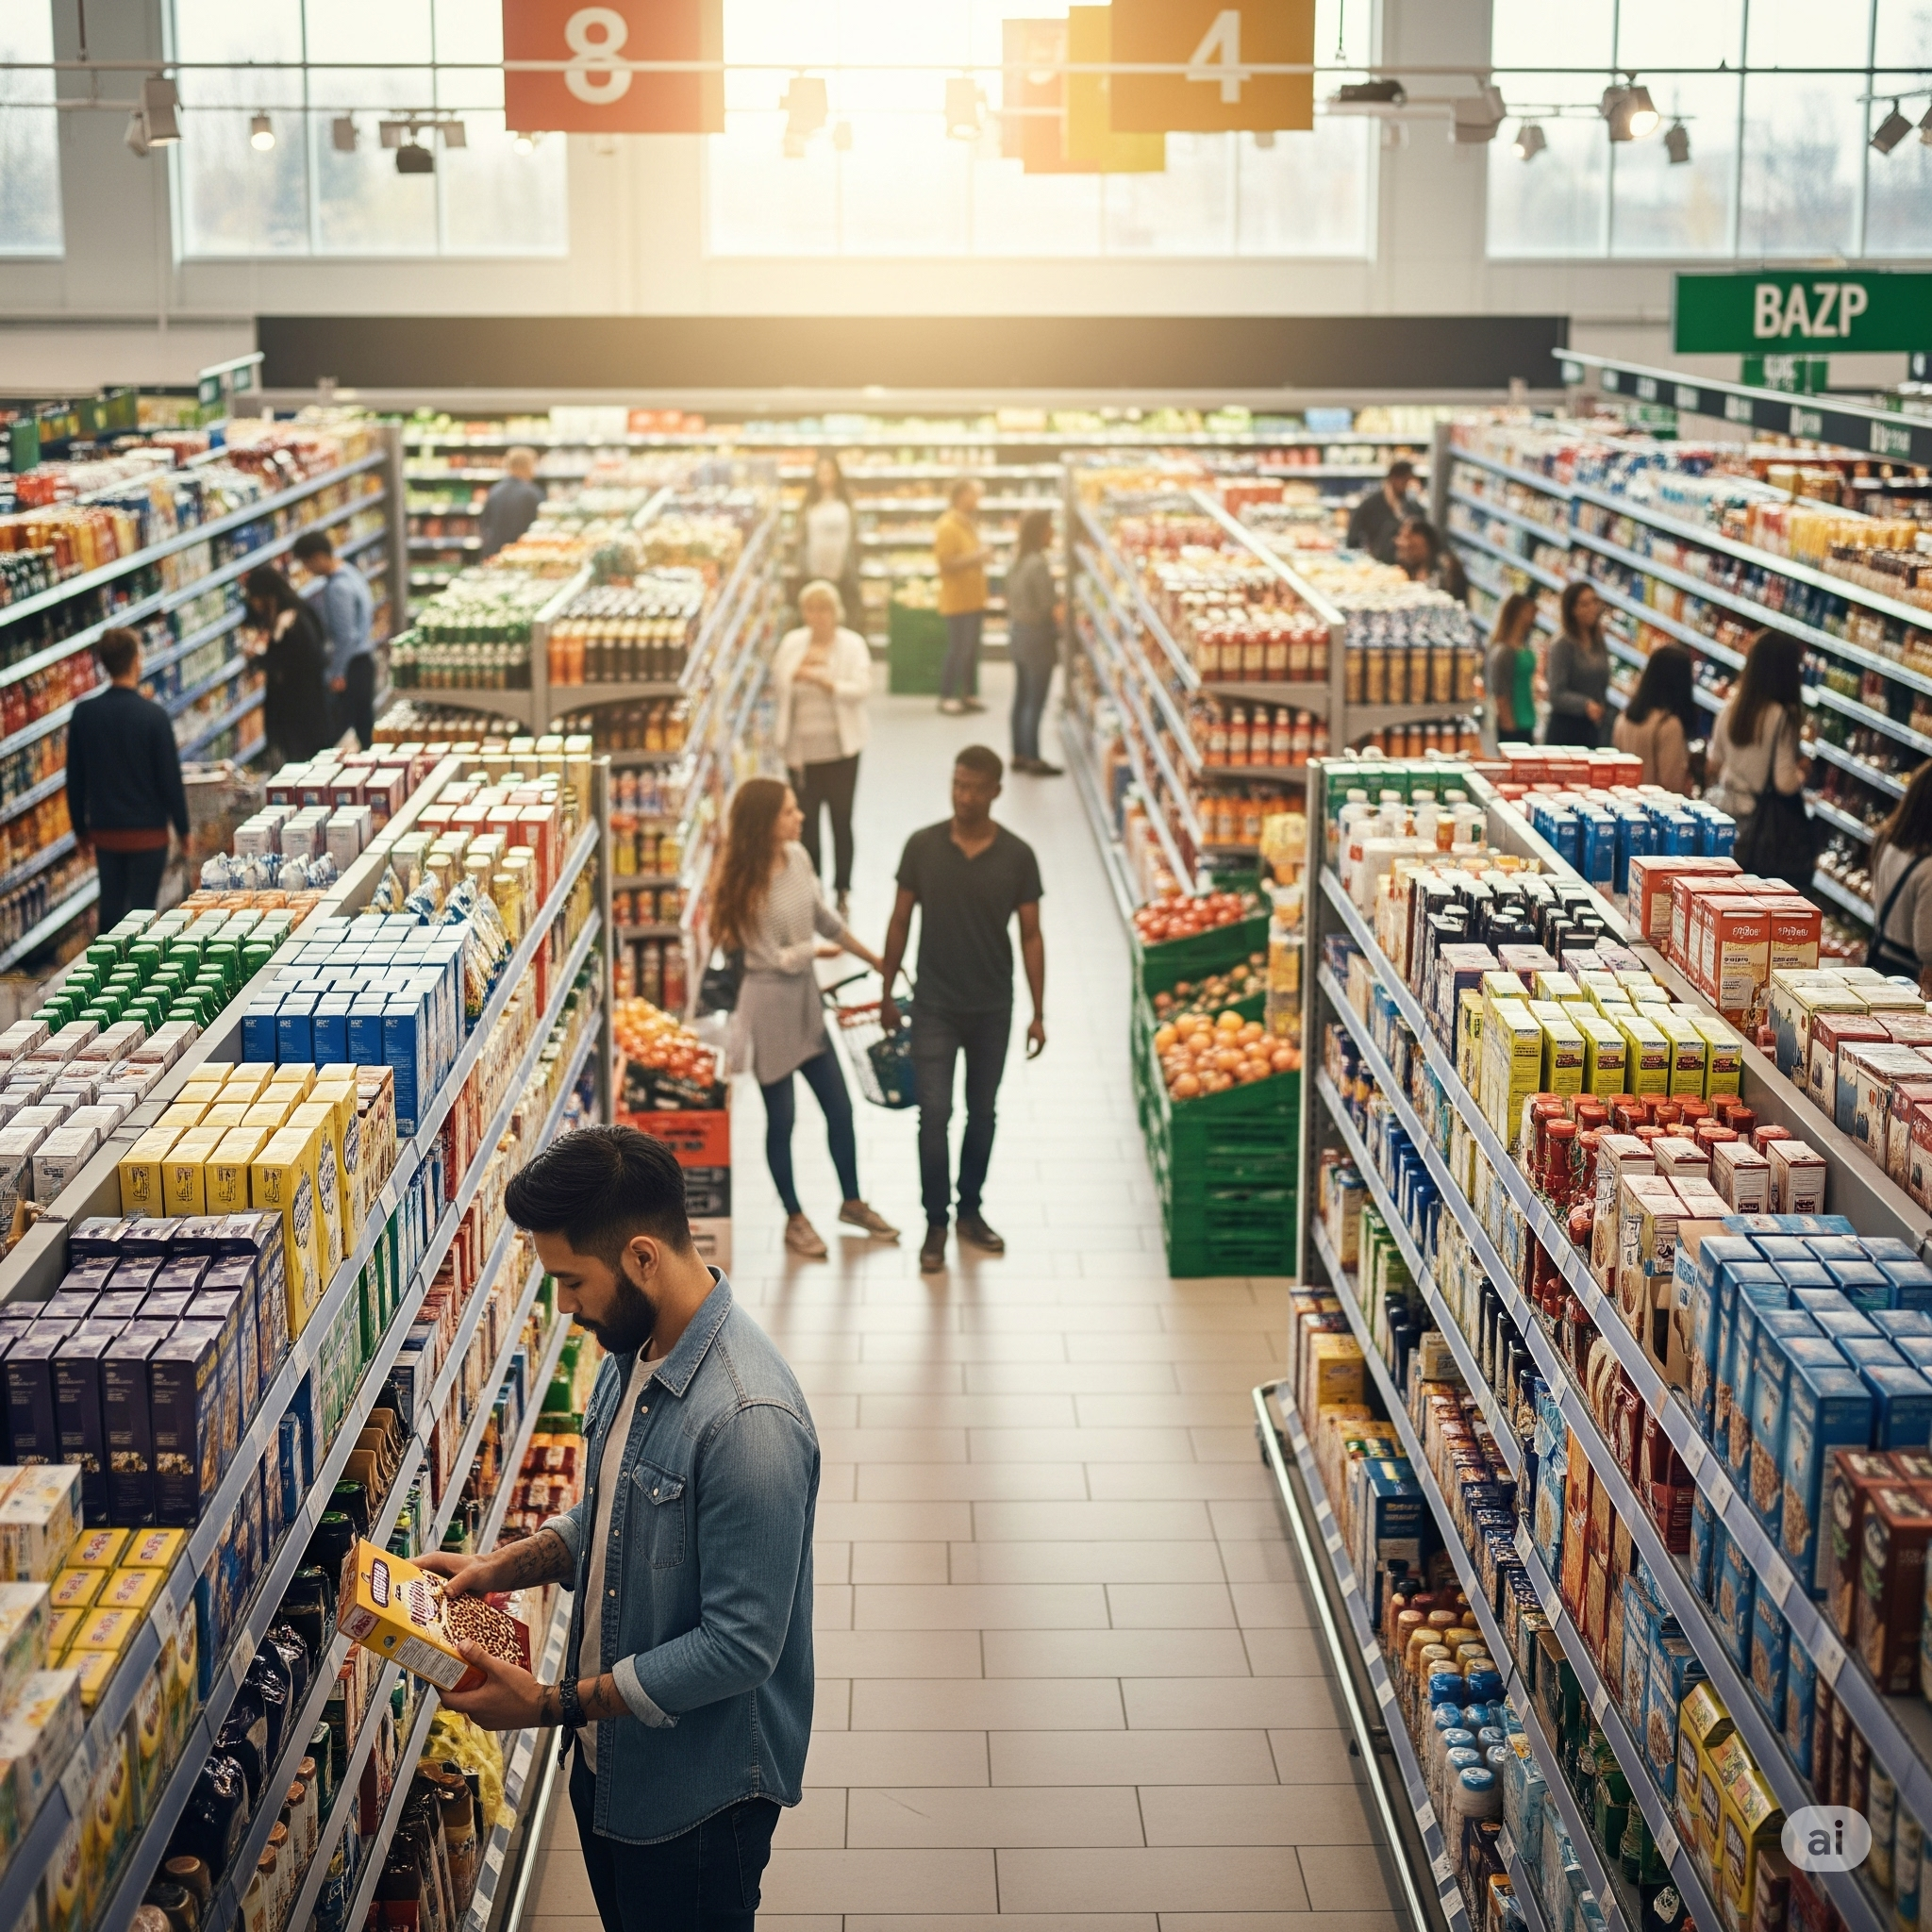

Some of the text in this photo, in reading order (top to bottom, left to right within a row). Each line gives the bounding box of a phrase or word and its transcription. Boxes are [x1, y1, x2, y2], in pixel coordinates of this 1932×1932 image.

[564, 7, 633, 106] 8
[1185, 9, 1252, 103] 4
[1754, 283, 1869, 339] BAZP
